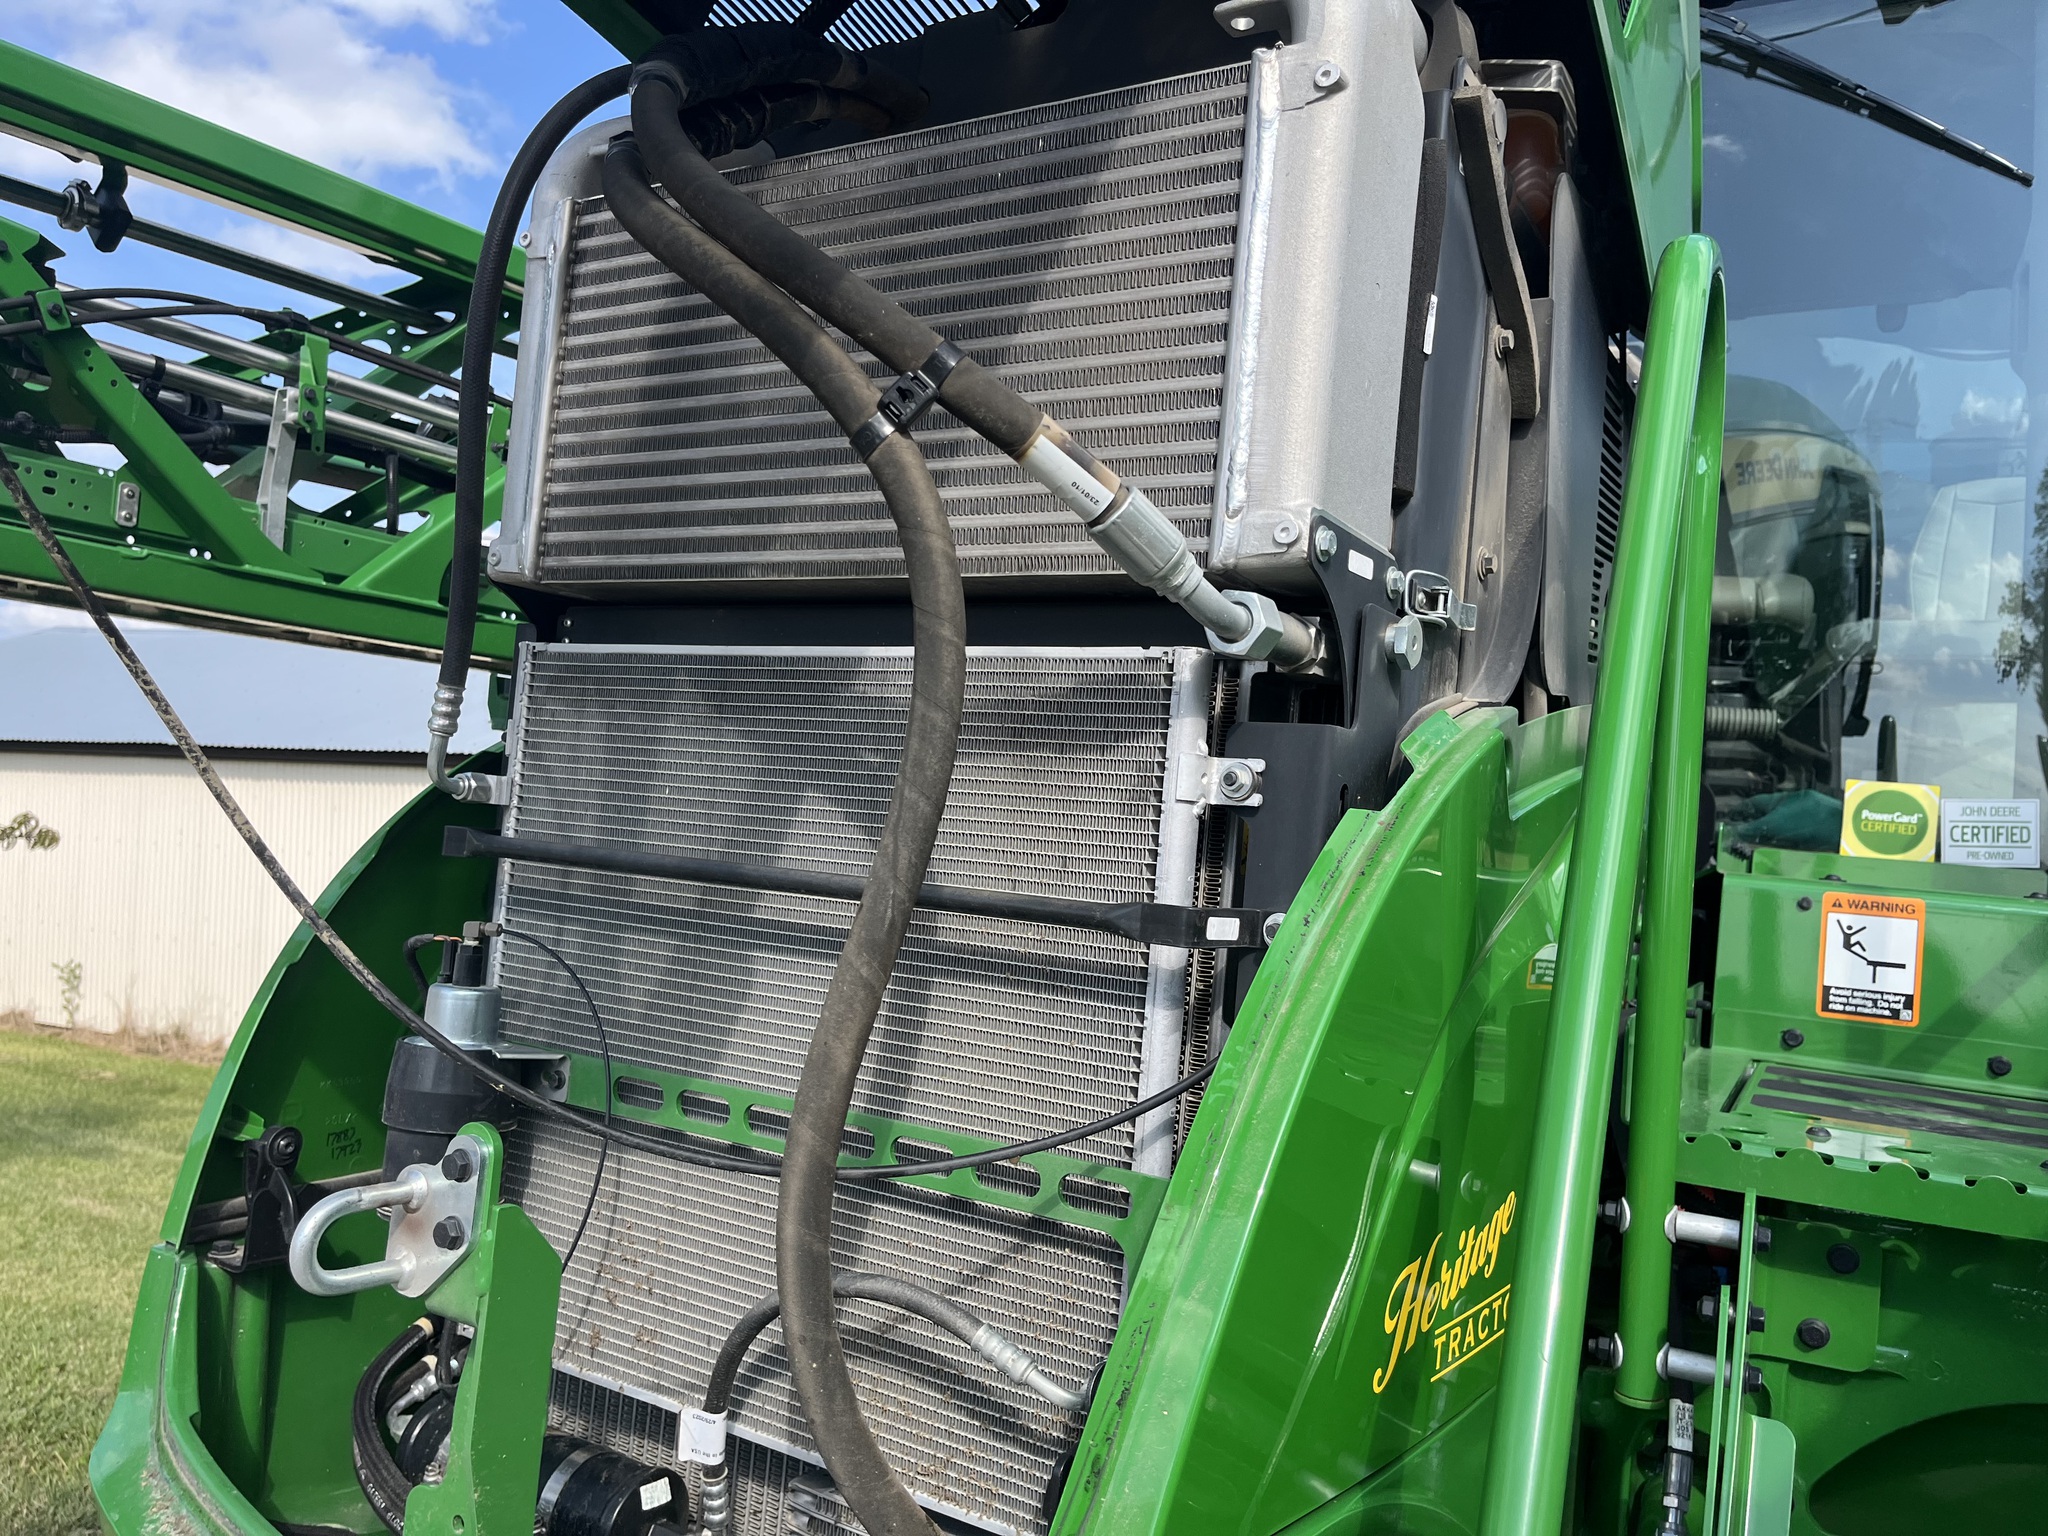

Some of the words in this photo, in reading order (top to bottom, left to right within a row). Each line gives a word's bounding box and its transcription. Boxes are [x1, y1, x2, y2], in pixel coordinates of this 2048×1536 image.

[1071, 481, 1100, 506] 23/01/10
[1959, 806, 1987, 817] JOHN
[1990, 806, 2021, 817] DEERE
[1860, 821, 1918, 836] CERTIFIED
[1950, 825, 2031, 843] CERTIFIED
[1966, 851, 2015, 861] PRE-OWNED
[1847, 898, 1916, 915] WARNING
[1829, 987, 1852, 997] Avoid
[1853, 989, 1882, 999] serious
[1883, 991, 1906, 1003] injury
[1829, 995, 1848, 1003] from
[1877, 1000, 1889, 1008] Do
[1890, 1000, 1904, 1009] not
[1828, 1003, 1844, 1011] ride
[1857, 1005, 1893, 1016] machine.
[1372, 1190, 1517, 1394] Heritage
[691, 1448, 701, 1456] USA
